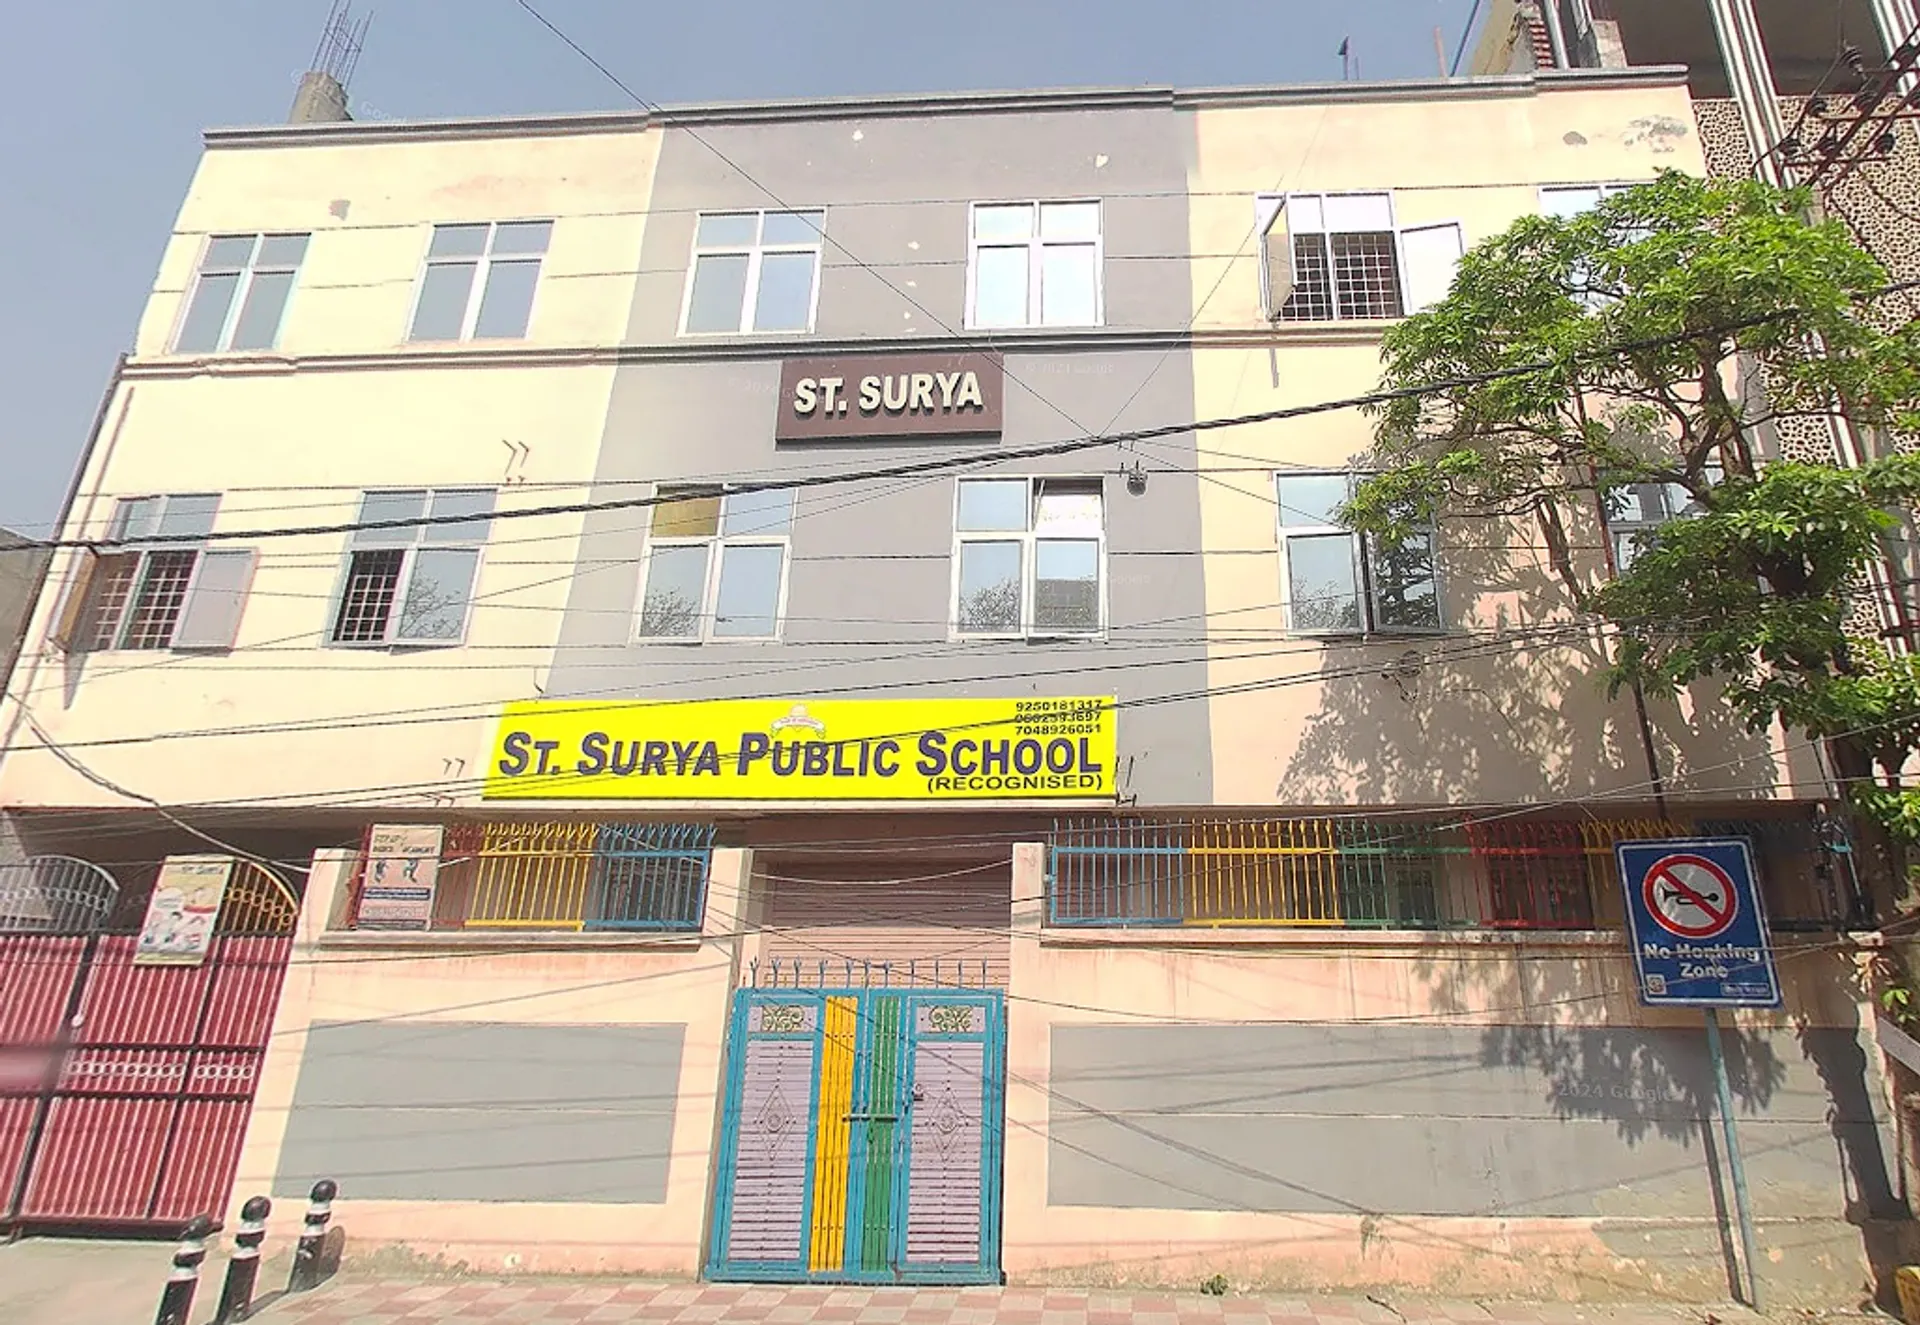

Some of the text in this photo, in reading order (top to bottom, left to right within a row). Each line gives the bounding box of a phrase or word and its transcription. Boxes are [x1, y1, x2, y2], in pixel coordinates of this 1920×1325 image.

[793, 377, 847, 413] ST.
[858, 371, 984, 411] SURYA
[1015, 724, 1102, 736] 7048926051
[499, 731, 1103, 778] ST. SURYA PUBLIC SCHOOL
[927, 774, 1103, 794] (RECOGNISED)
[1643, 943, 1761, 963] No Honking
[1680, 962, 1729, 978] Zone
